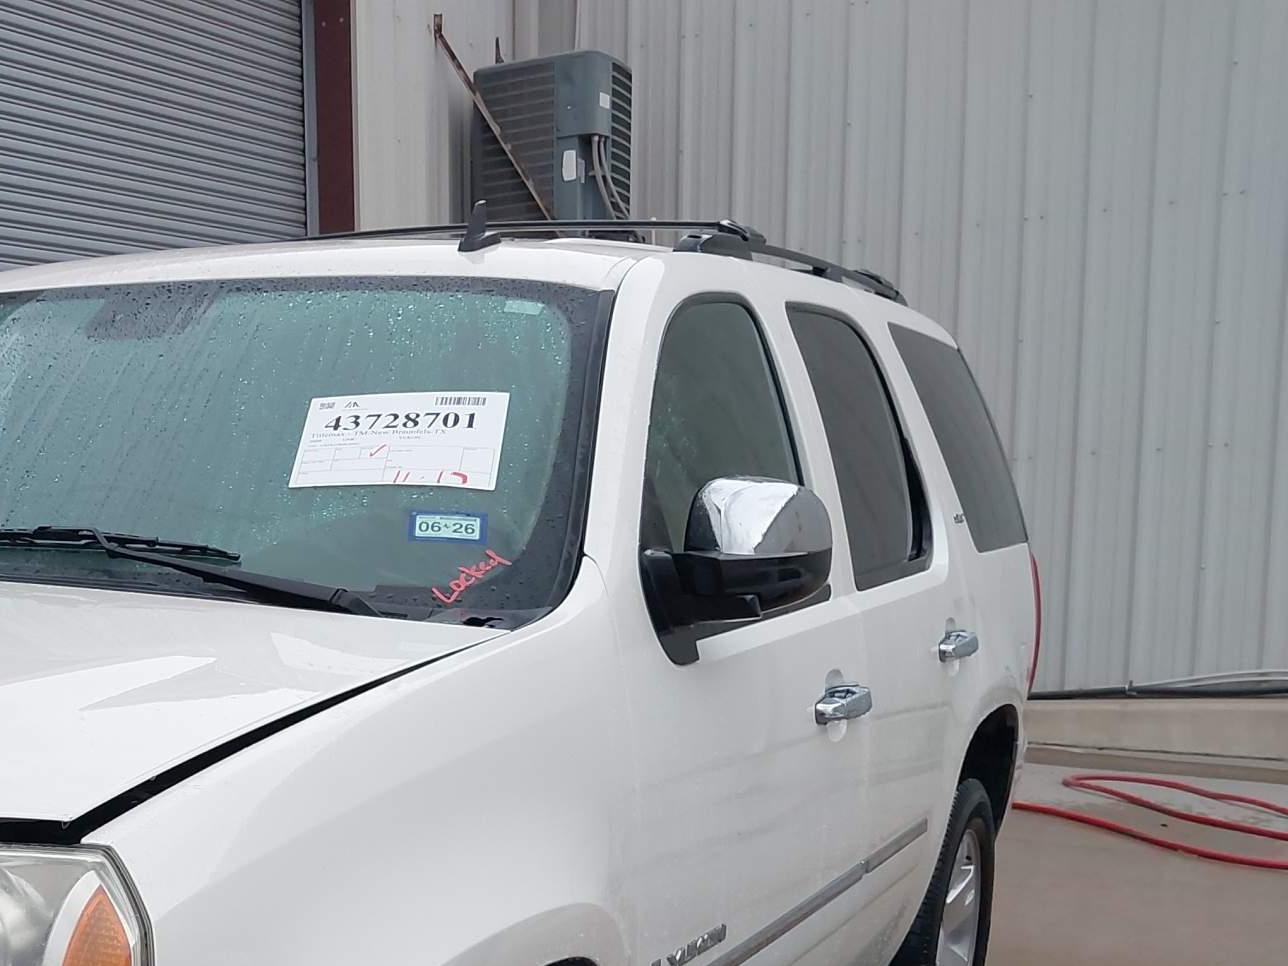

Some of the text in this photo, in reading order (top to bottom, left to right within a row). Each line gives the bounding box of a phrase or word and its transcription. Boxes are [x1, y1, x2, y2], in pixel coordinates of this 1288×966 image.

[324, 411, 476, 431] 43728701
[418, 521, 476, 535] 06 26
